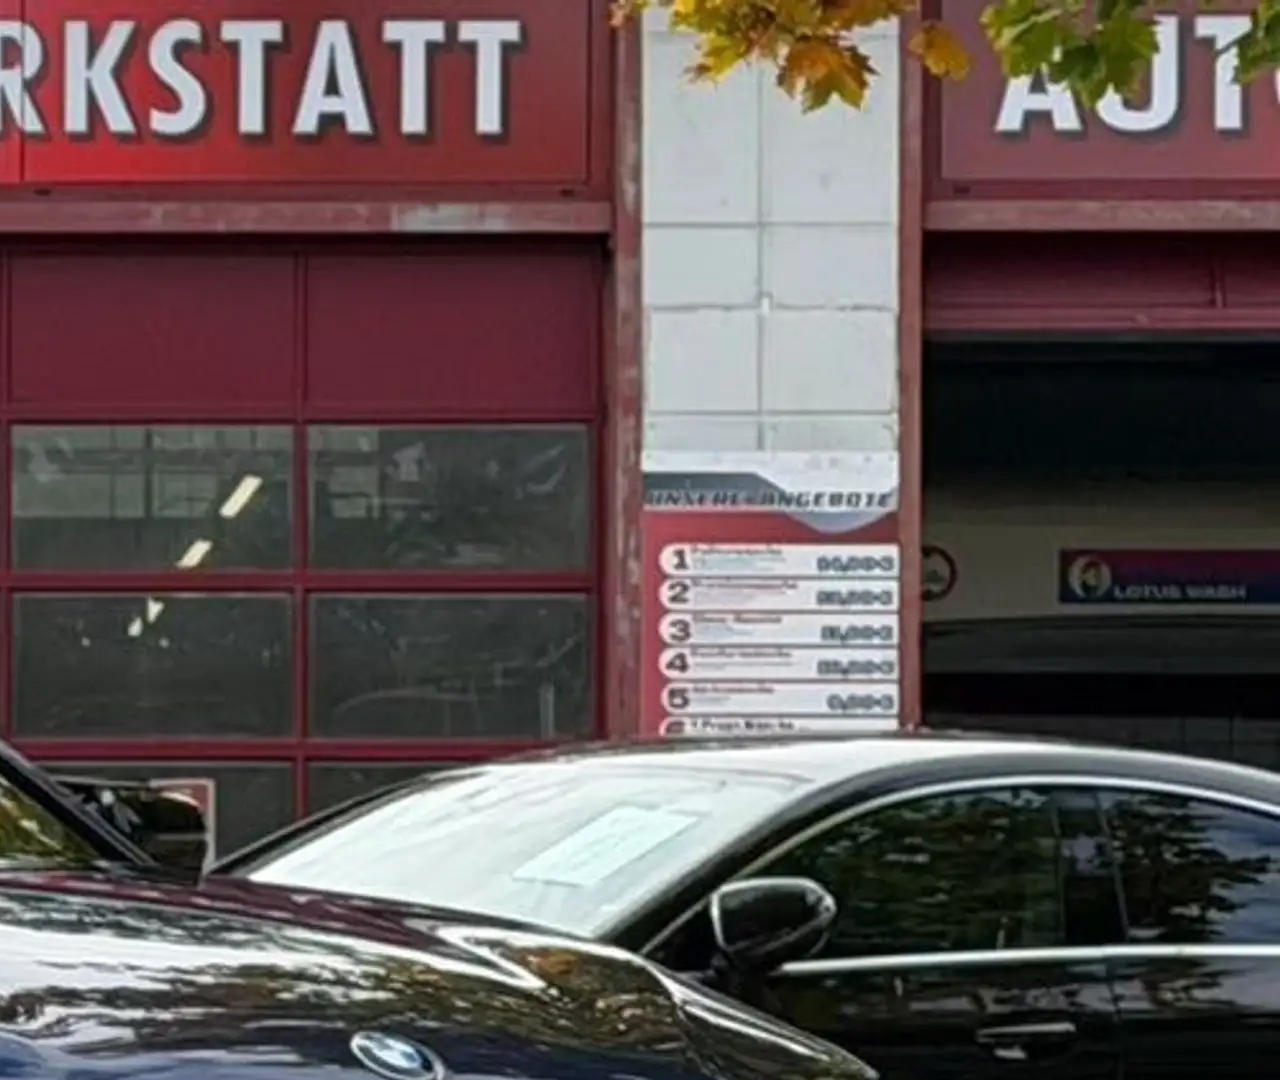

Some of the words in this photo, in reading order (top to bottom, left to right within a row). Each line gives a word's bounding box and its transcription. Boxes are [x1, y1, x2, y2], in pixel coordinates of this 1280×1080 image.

[995, 14, 1280, 132] AUT
[672, 550, 689, 570] 1
[668, 581, 690, 604] 2
[668, 619, 691, 641] 3
[665, 652, 689, 673] 4
[668, 687, 689, 709] 5
